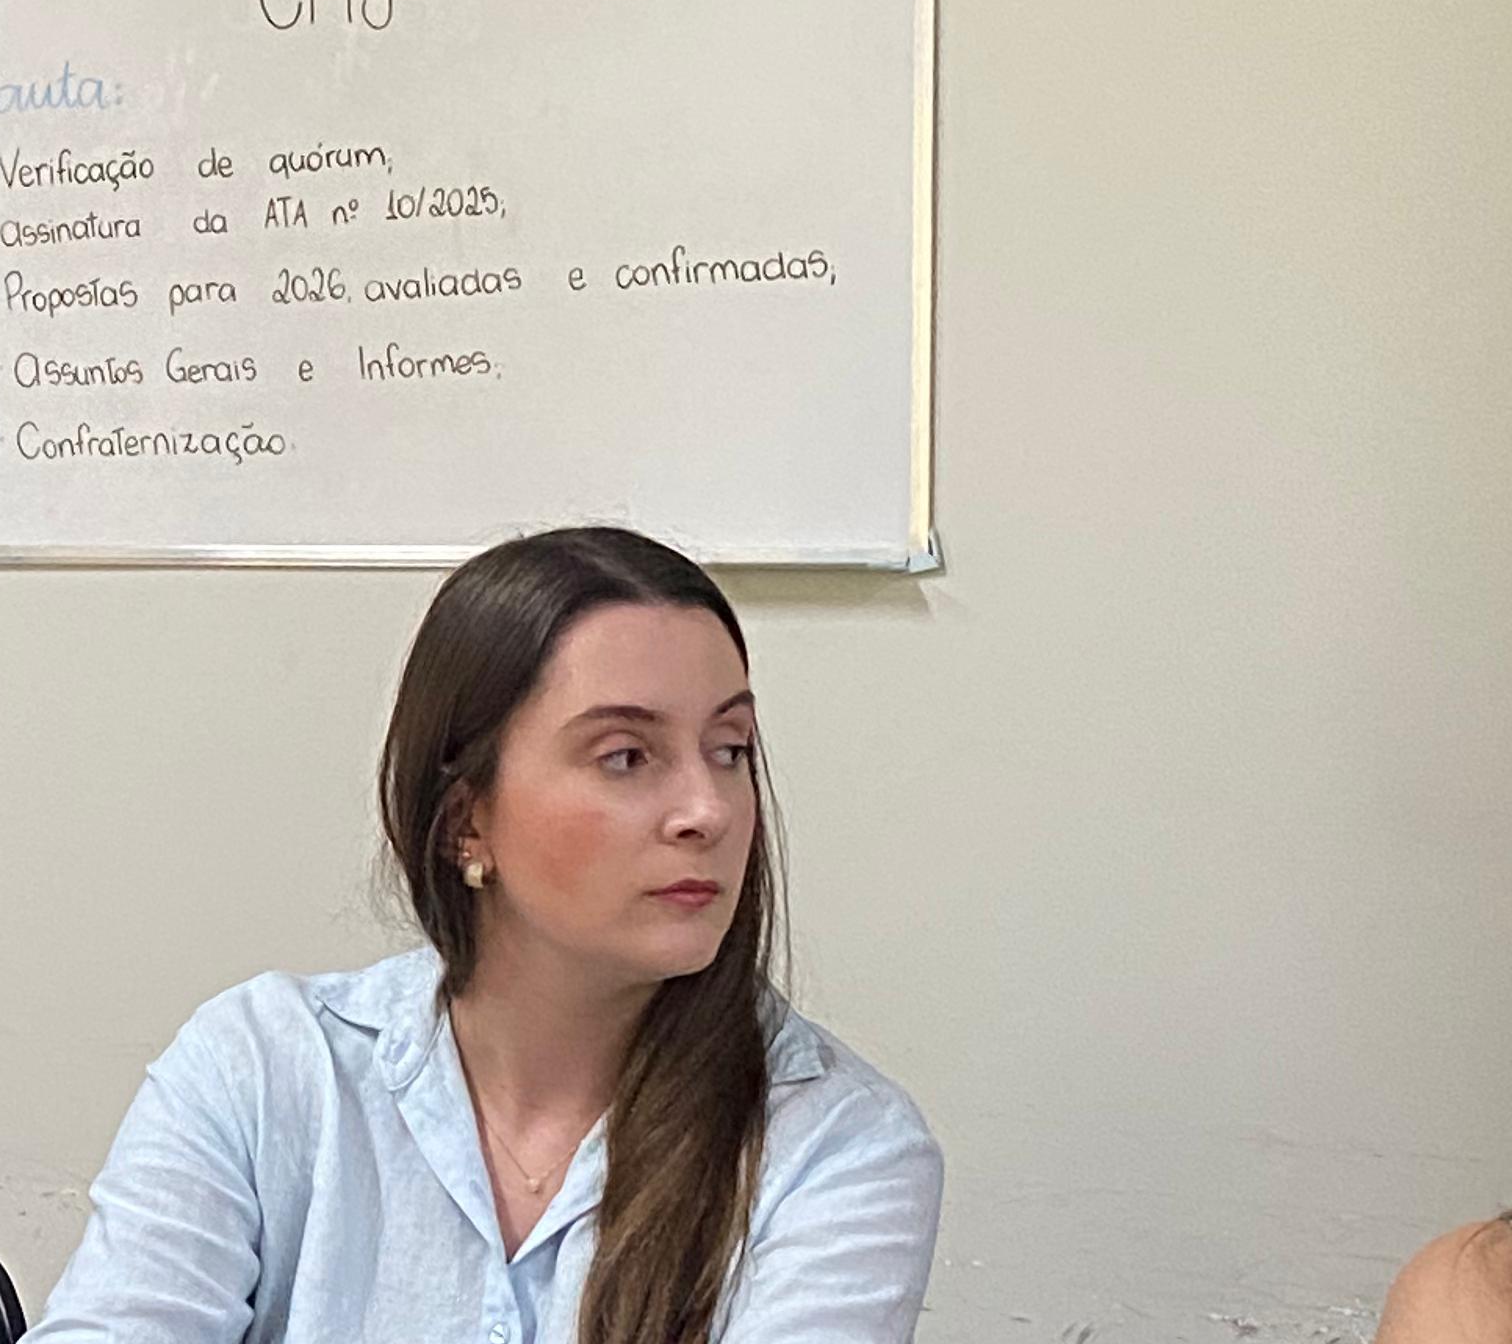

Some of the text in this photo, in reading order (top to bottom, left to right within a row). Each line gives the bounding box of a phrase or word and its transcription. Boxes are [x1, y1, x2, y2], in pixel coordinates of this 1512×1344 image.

[198, 147, 234, 178] de
[193, 209, 228, 234] da
[264, 196, 308, 229] ATA
[4, 270, 139, 318] Propostas
[169, 281, 237, 316] para
[364, 267, 523, 302] avaliadas
[568, 267, 587, 291] e
[166, 347, 258, 383] Gerais
[298, 359, 315, 382] e
